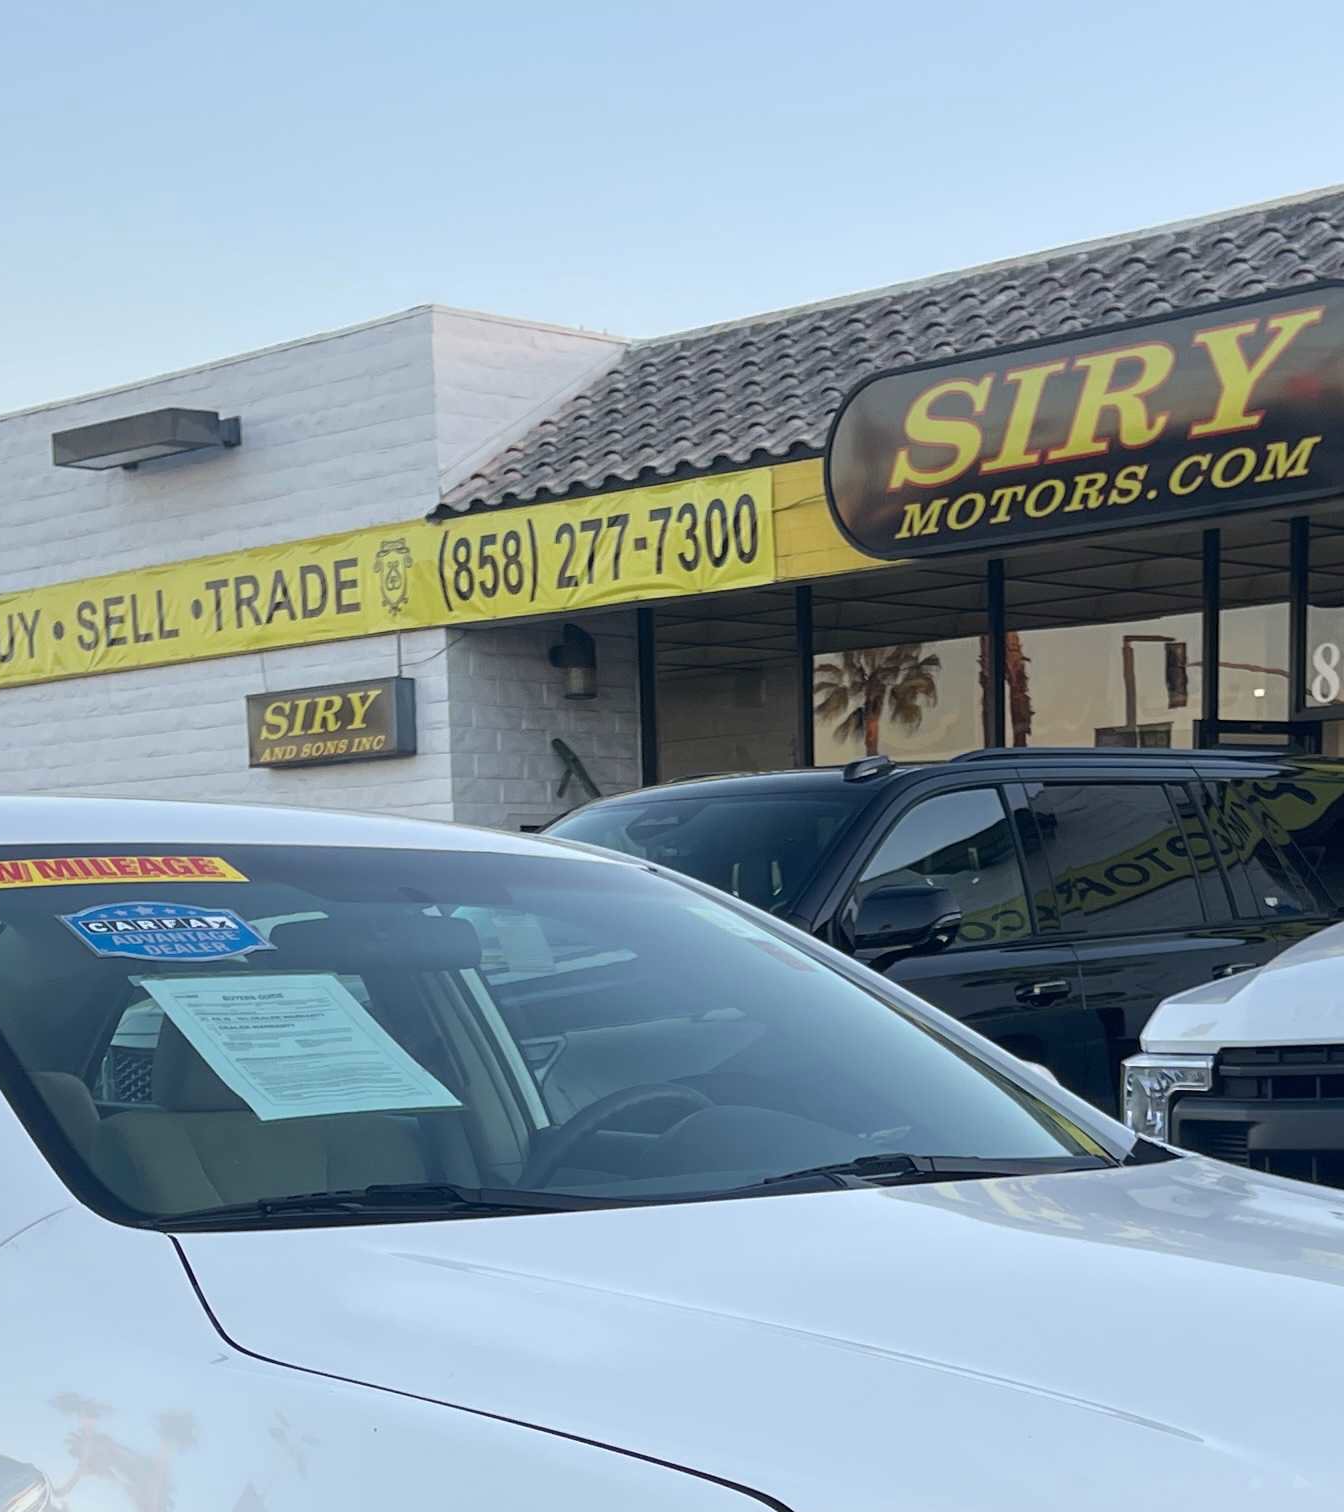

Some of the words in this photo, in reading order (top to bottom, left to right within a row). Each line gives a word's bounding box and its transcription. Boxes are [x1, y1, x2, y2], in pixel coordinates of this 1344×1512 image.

[889, 306, 1326, 492] SIRY
[894, 436, 1322, 540] MOTORS.COM
[439, 518, 538, 611] (858)
[556, 494, 758, 589] 277-7300
[77, 590, 179, 651] SELL
[204, 557, 361, 632] TRADE
[260, 689, 382, 740] SIRY
[259, 745, 297, 762] AND
[300, 739, 349, 758] SONS
[351, 735, 386, 752] INC
[31, 856, 223, 881] MILEAGE
[84, 916, 240, 934] CARFAX
[111, 930, 241, 946] ADVANTAGE
[143, 942, 233, 956] DEALER
